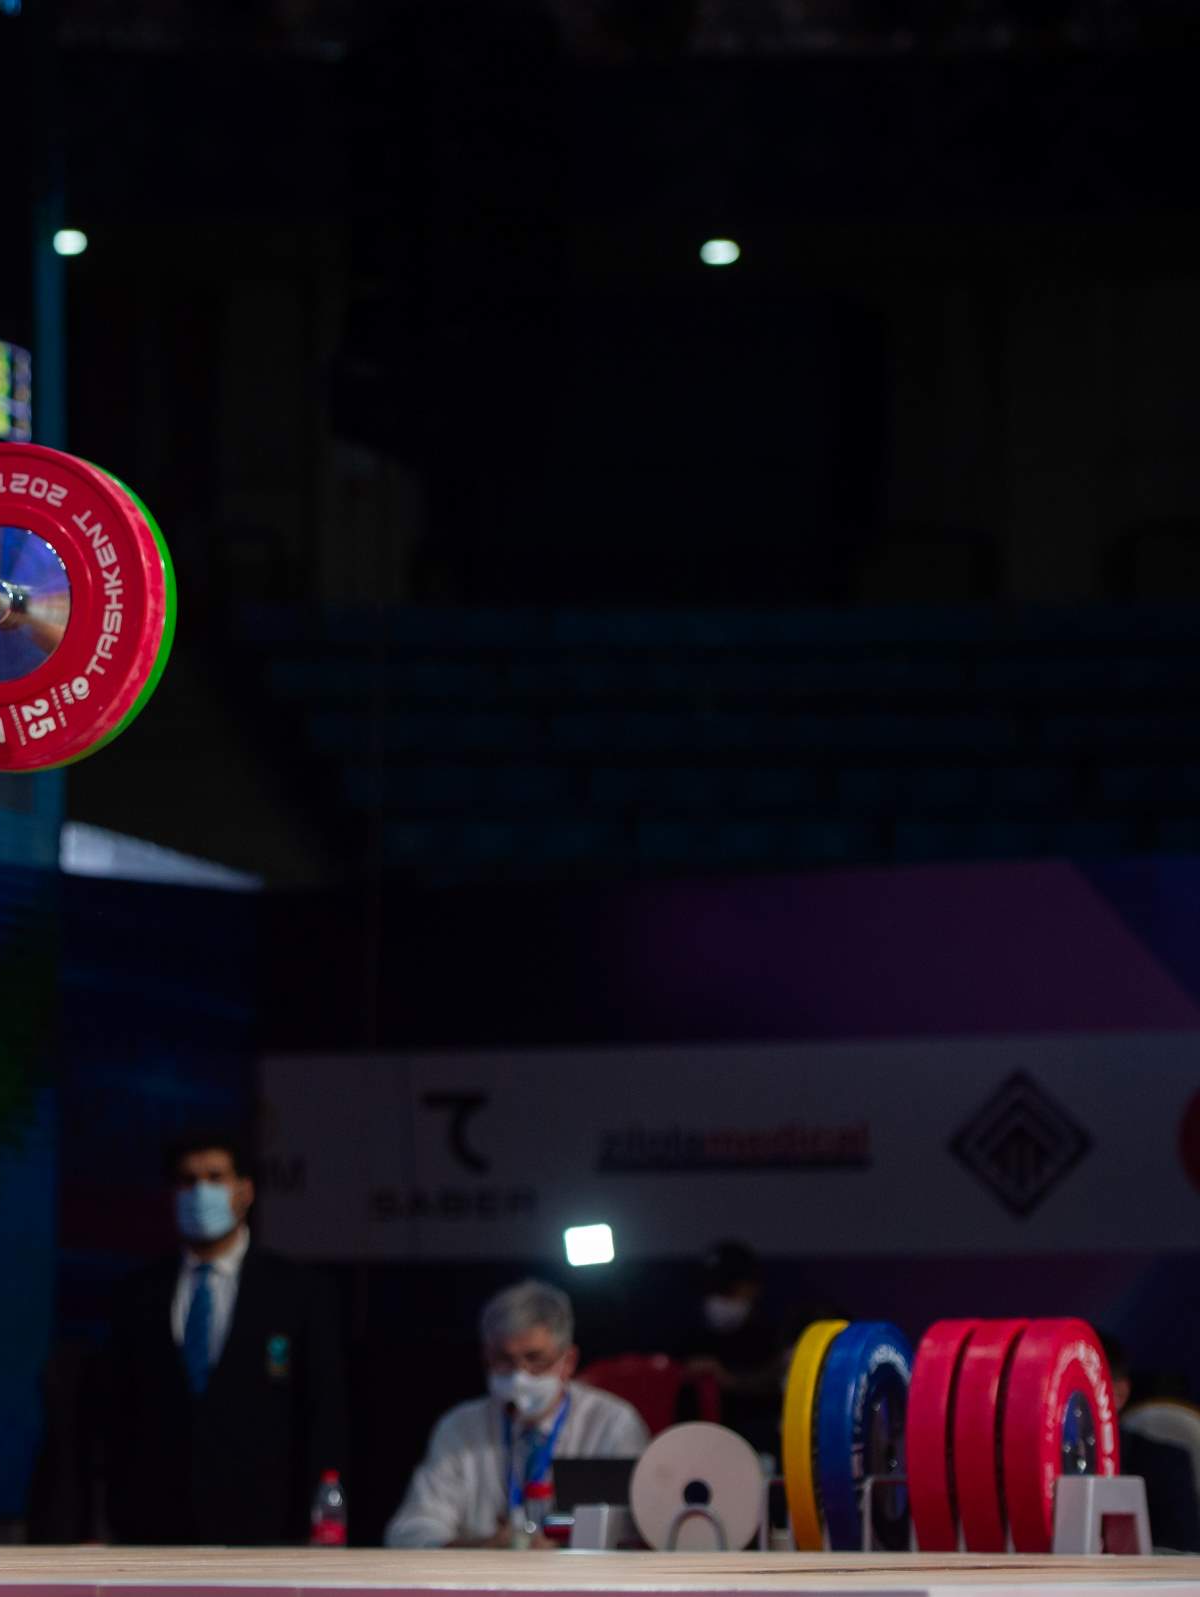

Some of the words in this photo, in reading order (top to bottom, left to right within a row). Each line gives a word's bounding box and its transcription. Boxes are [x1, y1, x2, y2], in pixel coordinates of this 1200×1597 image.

[71, 509, 125, 676] TASHKENT
[59, 682, 76, 705] IWF
[20, 698, 57, 740] 25
